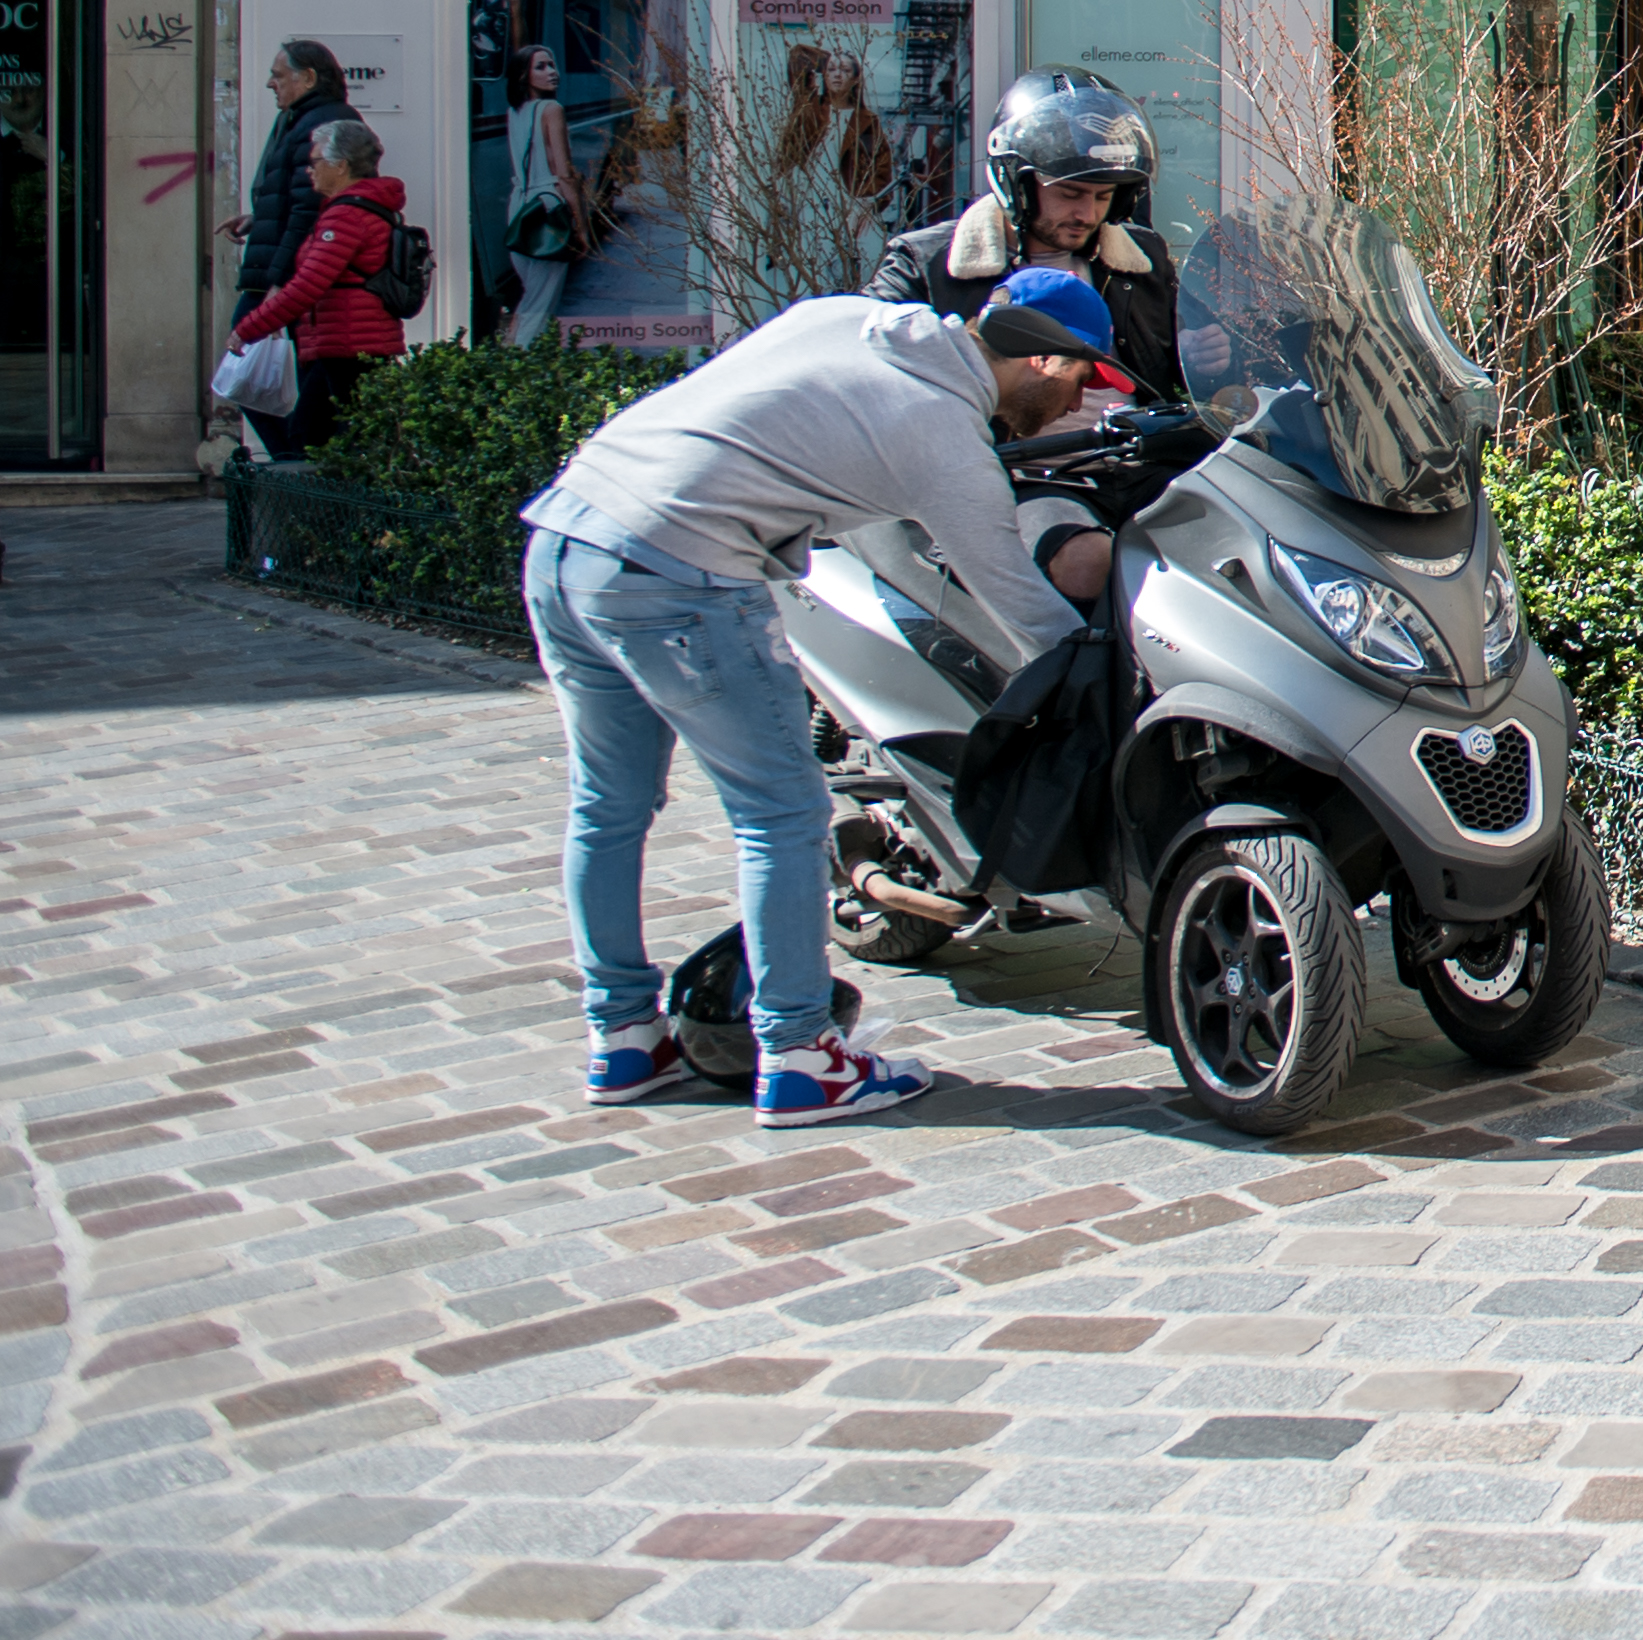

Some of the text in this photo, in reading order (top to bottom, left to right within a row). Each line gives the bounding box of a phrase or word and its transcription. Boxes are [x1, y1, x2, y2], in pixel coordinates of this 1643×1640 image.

[751, 0, 882, 17] Coming Soon
[1081, 46, 1166, 62] elleme.com
[0, 72, 42, 87] TIONS
[1159, 146, 1178, 155] uval
[568, 323, 646, 341] Coming
